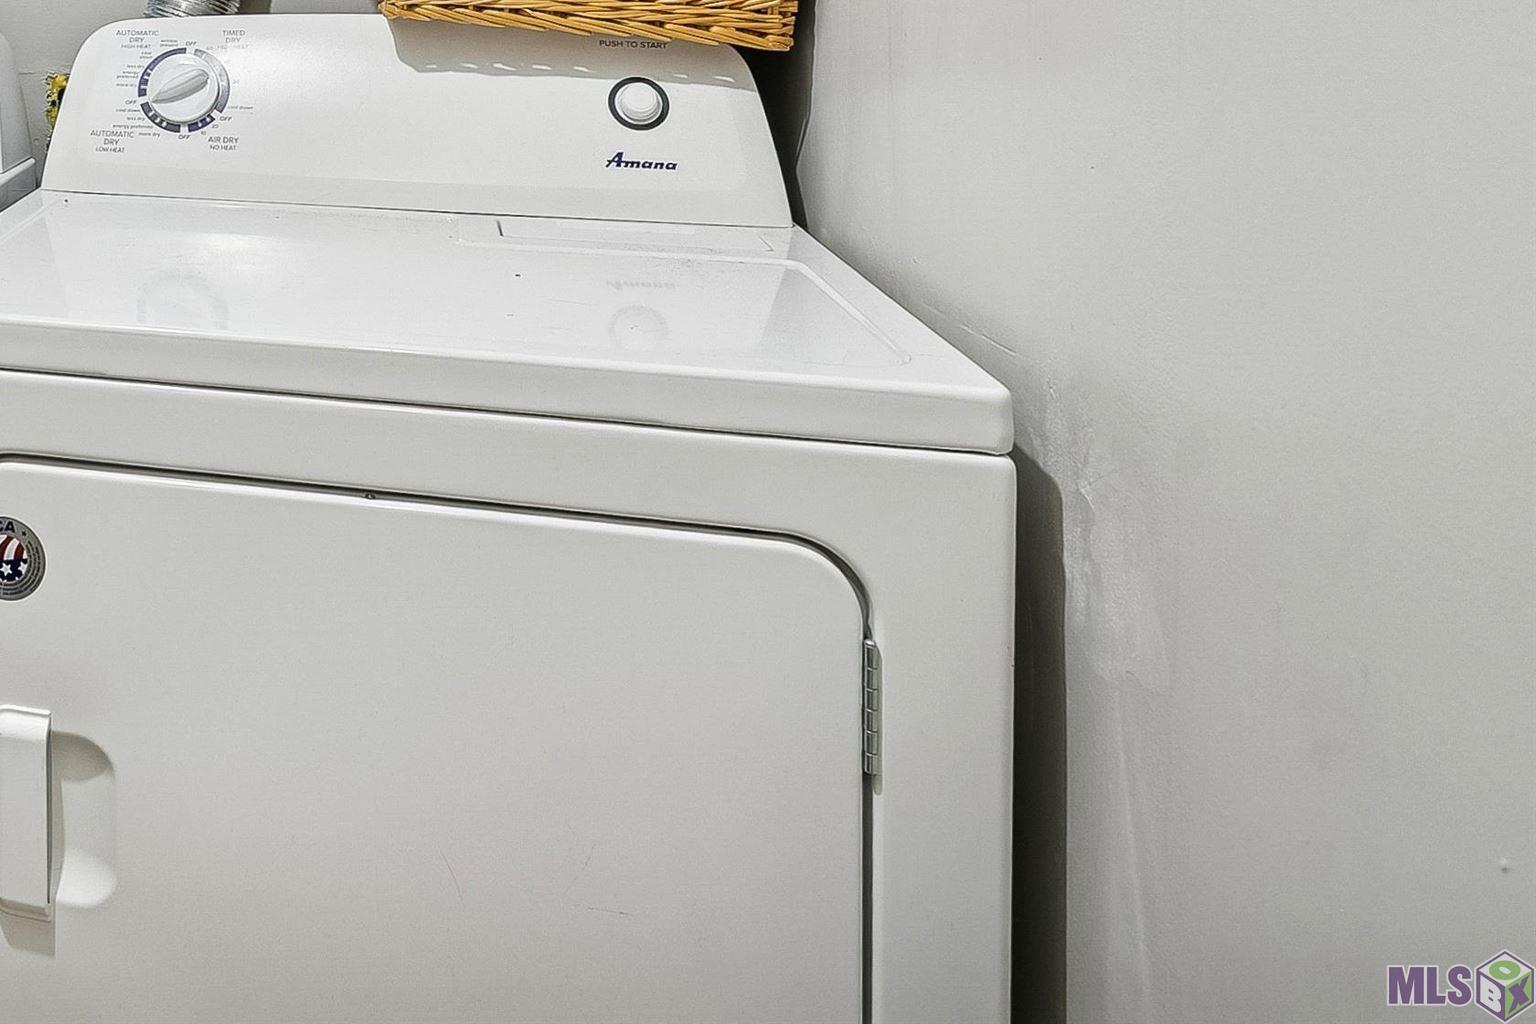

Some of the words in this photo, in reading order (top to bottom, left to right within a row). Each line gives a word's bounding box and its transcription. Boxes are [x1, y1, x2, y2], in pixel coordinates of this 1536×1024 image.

[599, 39, 623, 48] PUSH
[626, 40, 638, 48] TO
[640, 41, 668, 49] START
[90, 129, 134, 138] AUTOMATIC
[223, 136, 239, 144] DRY
[606, 151, 678, 171] Amana
